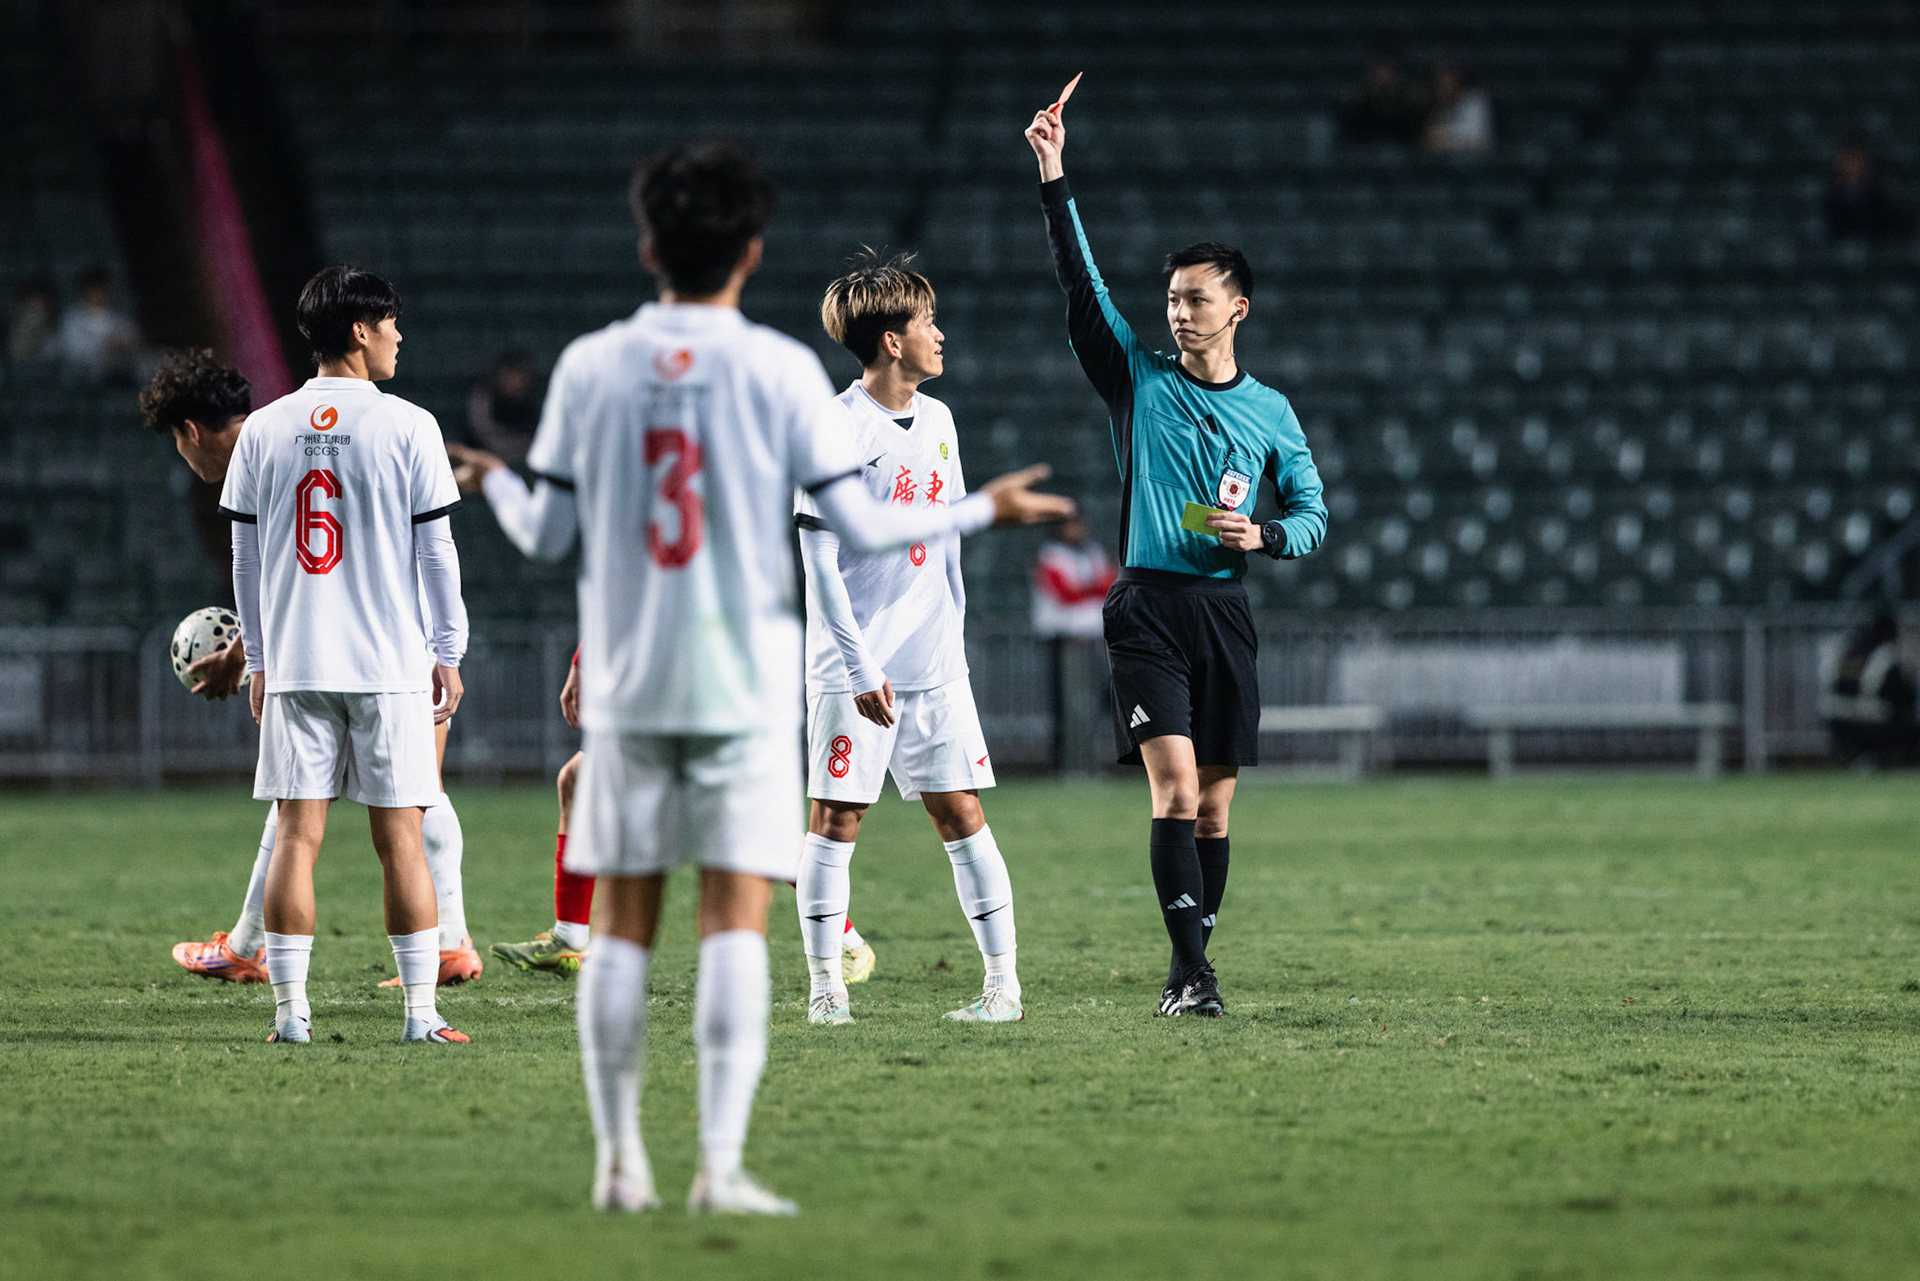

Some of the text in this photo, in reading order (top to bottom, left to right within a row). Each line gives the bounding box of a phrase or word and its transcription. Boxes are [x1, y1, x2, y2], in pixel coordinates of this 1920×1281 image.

[295, 434, 351, 445] 广州轻工集团
[304, 446, 339, 456] GCGS
[643, 422, 703, 571] 3
[891, 465, 947, 509] 廣東
[296, 469, 343, 575] 6
[828, 735, 852, 778] 8
